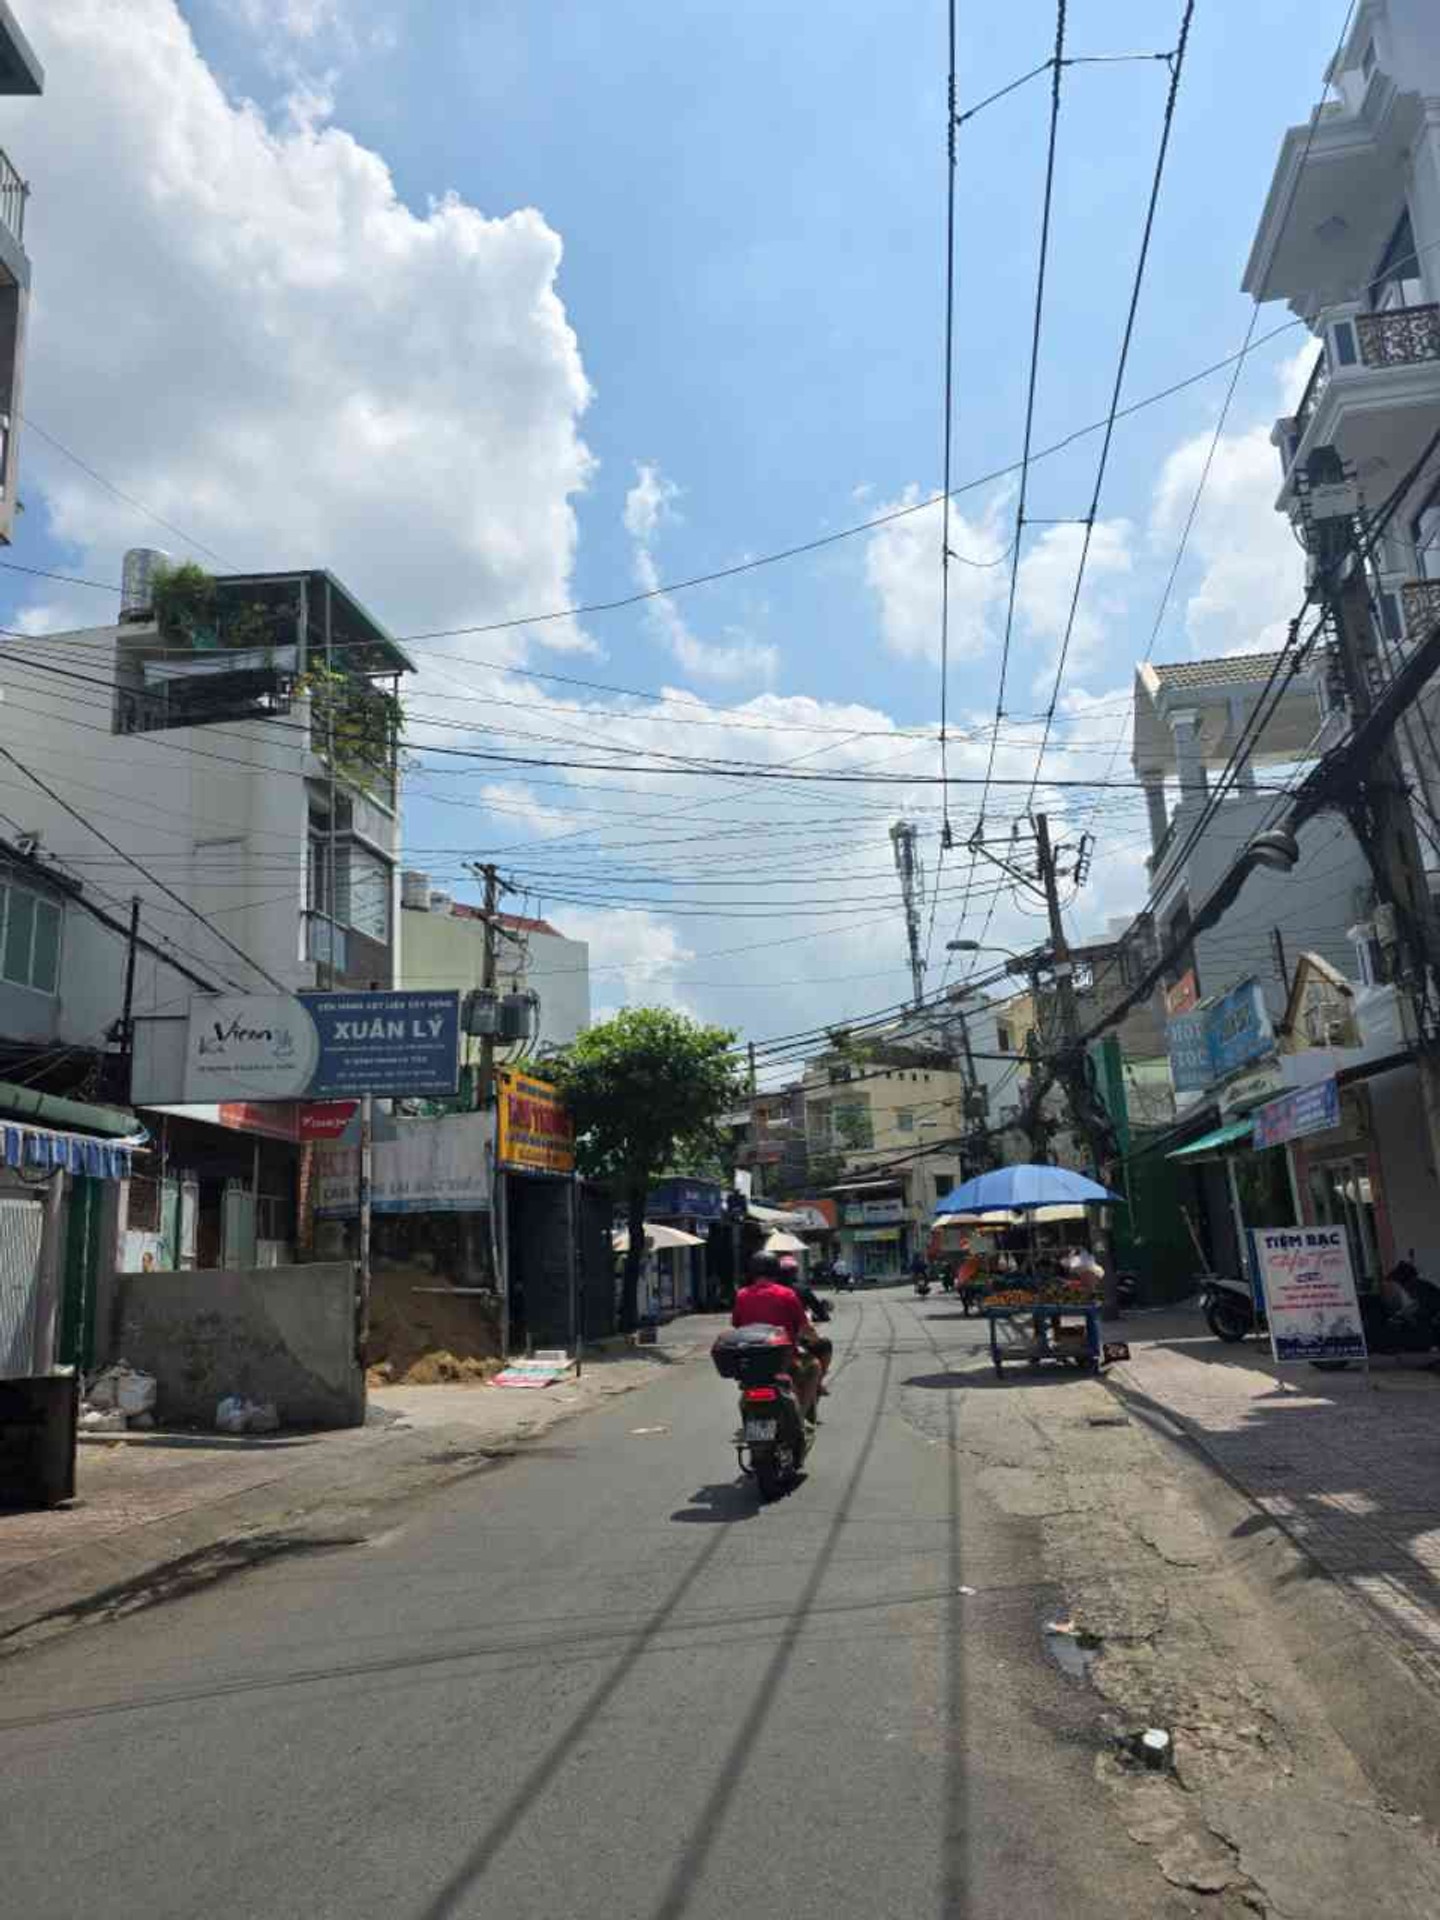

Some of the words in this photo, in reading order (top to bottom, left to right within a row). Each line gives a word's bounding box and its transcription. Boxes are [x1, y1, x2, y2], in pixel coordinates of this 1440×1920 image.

[334, 1017, 405, 1040] XUÂN
[1265, 1232, 1303, 1251] TIỆM
[1305, 1232, 1341, 1249] BẠC
